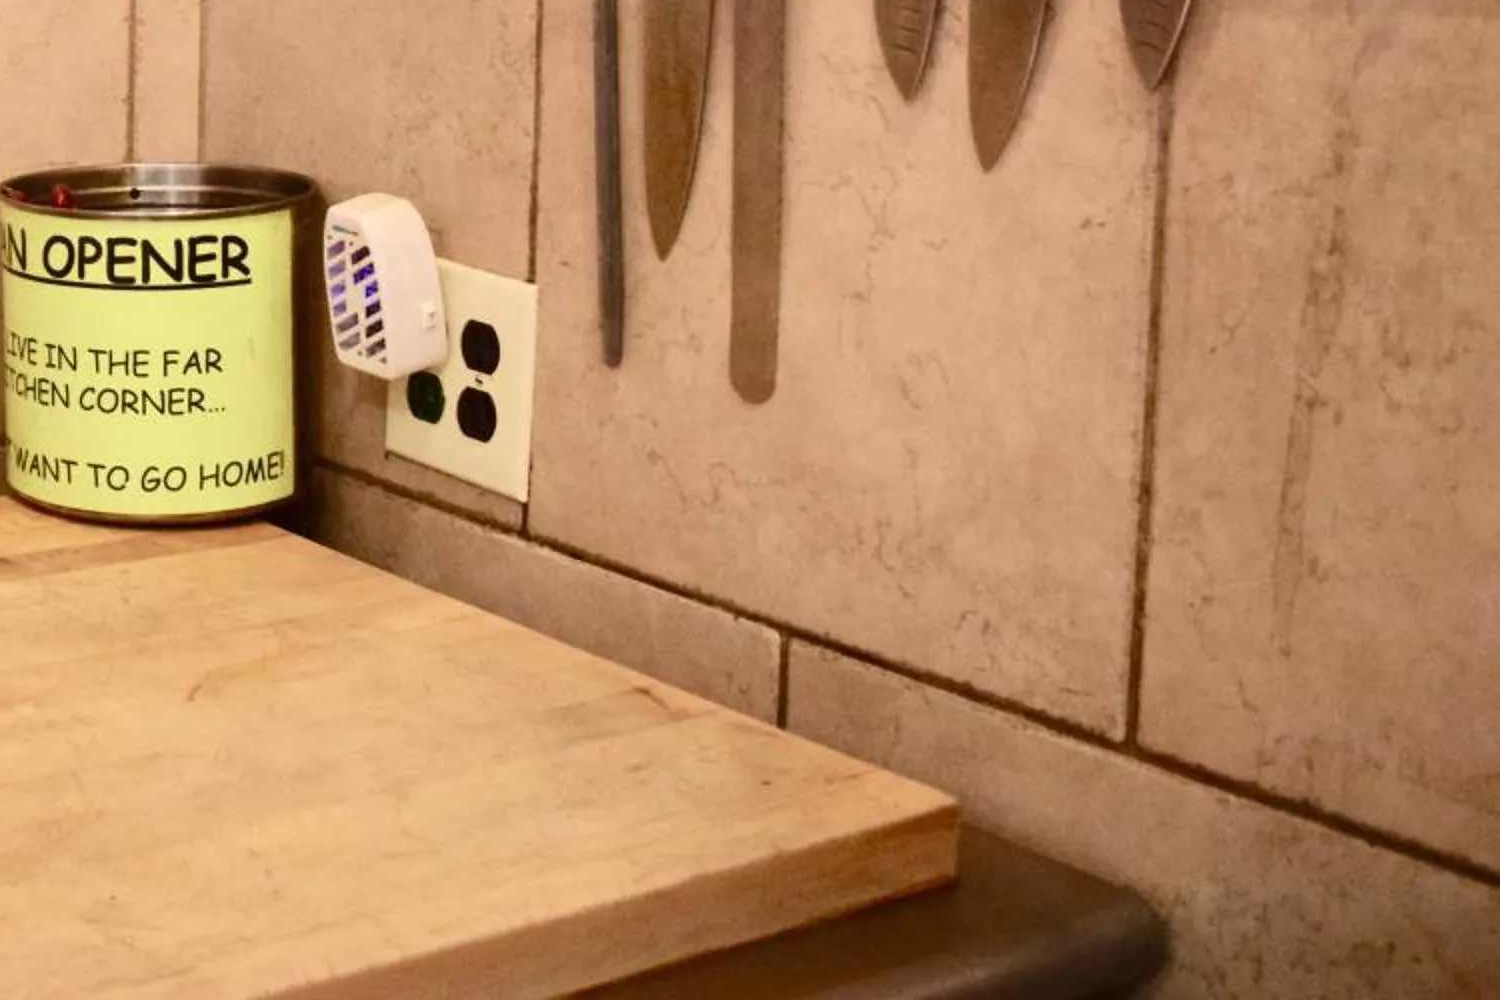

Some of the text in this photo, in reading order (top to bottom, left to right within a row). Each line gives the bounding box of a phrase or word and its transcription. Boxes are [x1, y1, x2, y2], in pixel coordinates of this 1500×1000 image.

[1, 223, 250, 284] N OPENER
[45, 343, 77, 372] IN
[88, 348, 149, 377] THE
[163, 347, 223, 377] FAR
[3, 363, 226, 415] TCHEN CORNER...
[13, 443, 78, 484] WANT
[87, 463, 130, 491] TO
[141, 465, 187, 492] GO
[199, 449, 285, 490] HOME!
